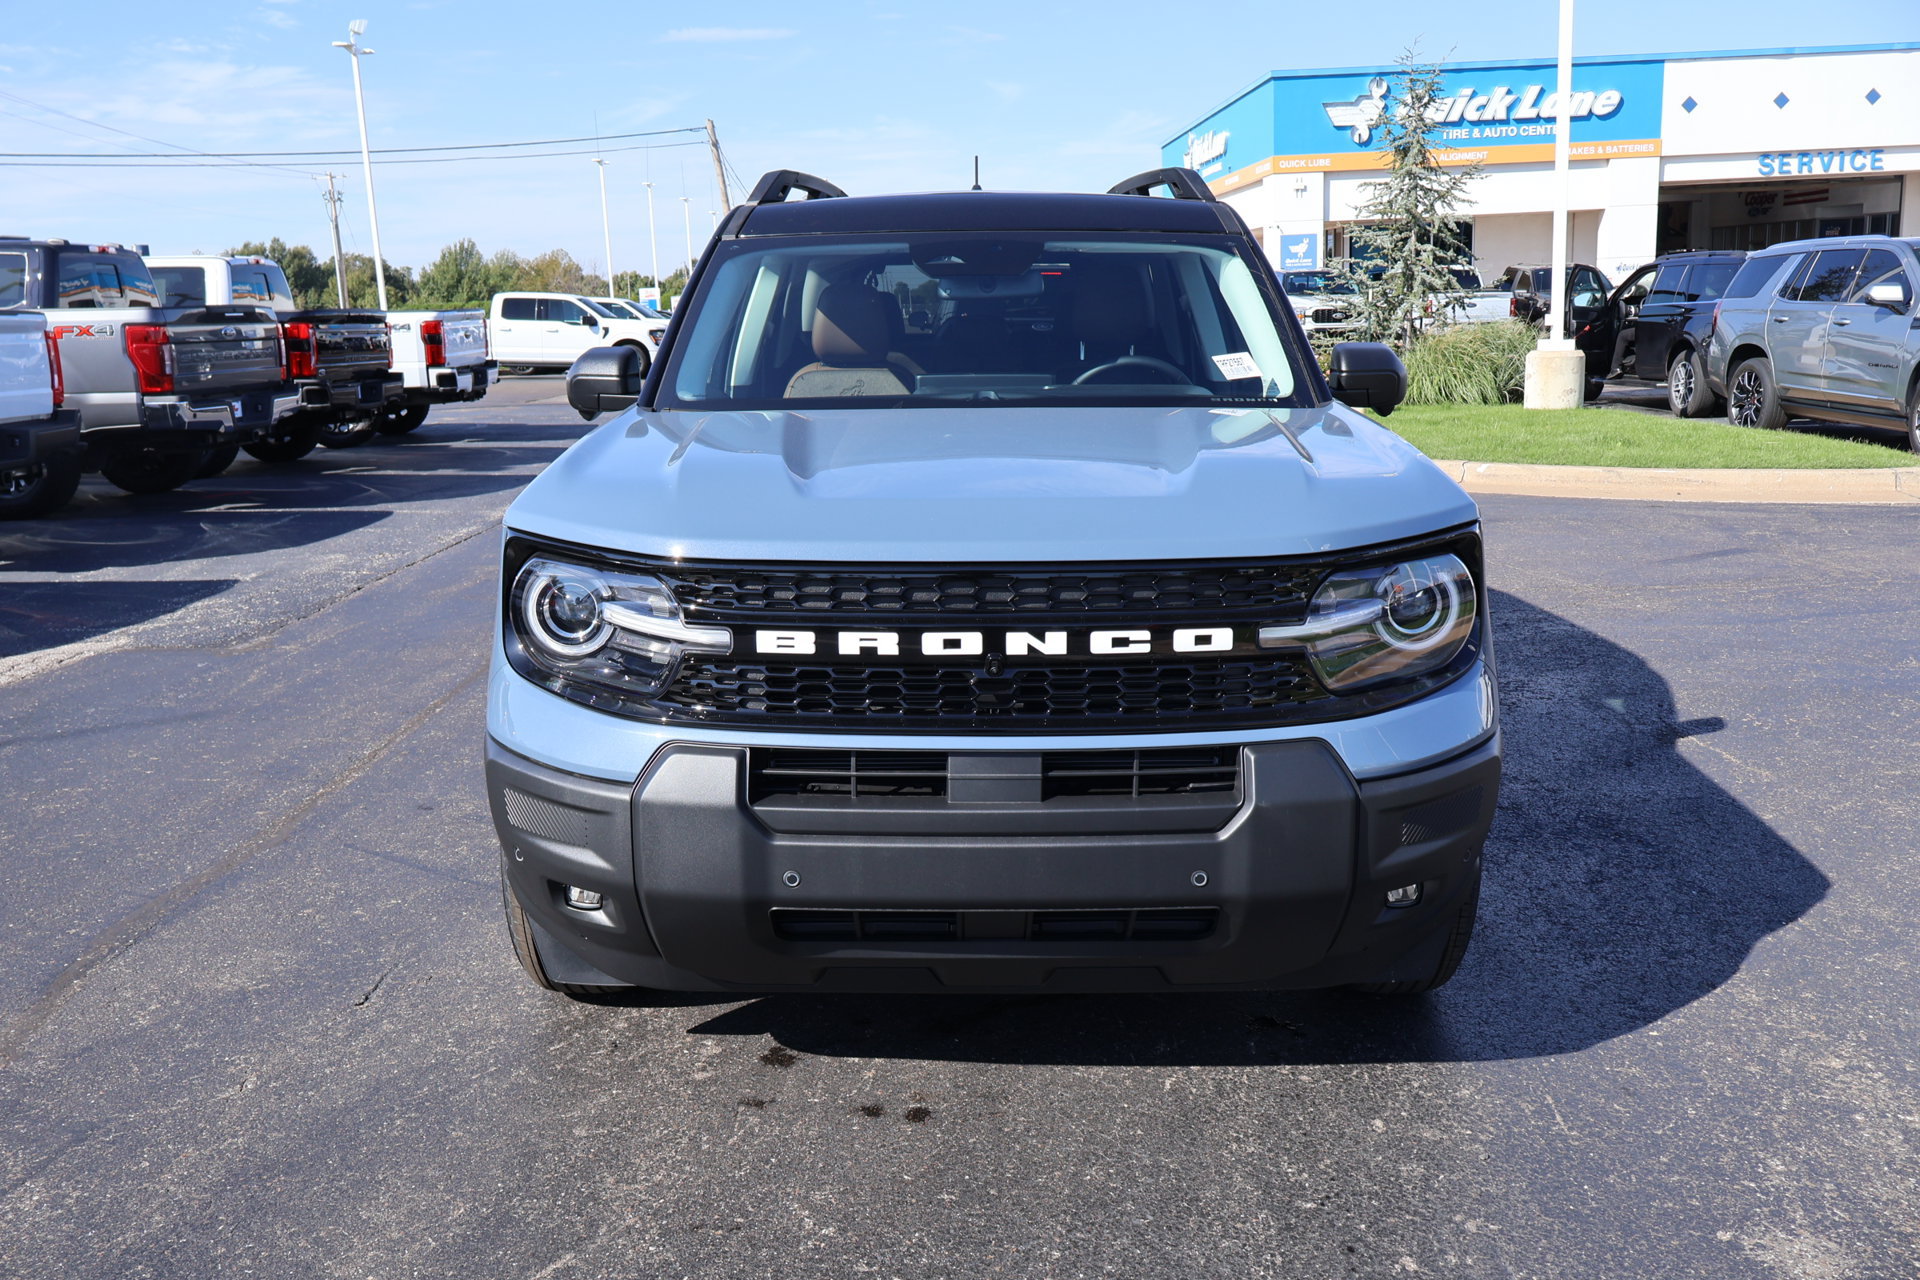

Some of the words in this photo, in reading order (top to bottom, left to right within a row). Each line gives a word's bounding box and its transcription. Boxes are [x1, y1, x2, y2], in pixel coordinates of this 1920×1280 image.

[1513, 85, 1621, 118] Lane
[1443, 127, 1470, 139] TIRE
[1472, 128, 1481, 138] &
[1483, 126, 1517, 137] AUTO
[1520, 124, 1557, 136] CENT
[1440, 150, 1488, 160] ALIGNMENT
[1568, 147, 1595, 155] AKES
[1606, 143, 1655, 153] BATTERIES
[1279, 160, 1306, 168] QUICK
[1308, 158, 1331, 167] LUBE
[1758, 149, 1884, 176] SERVICE
[53, 324, 115, 340] FX4
[756, 627, 1234, 656] BRONCO
